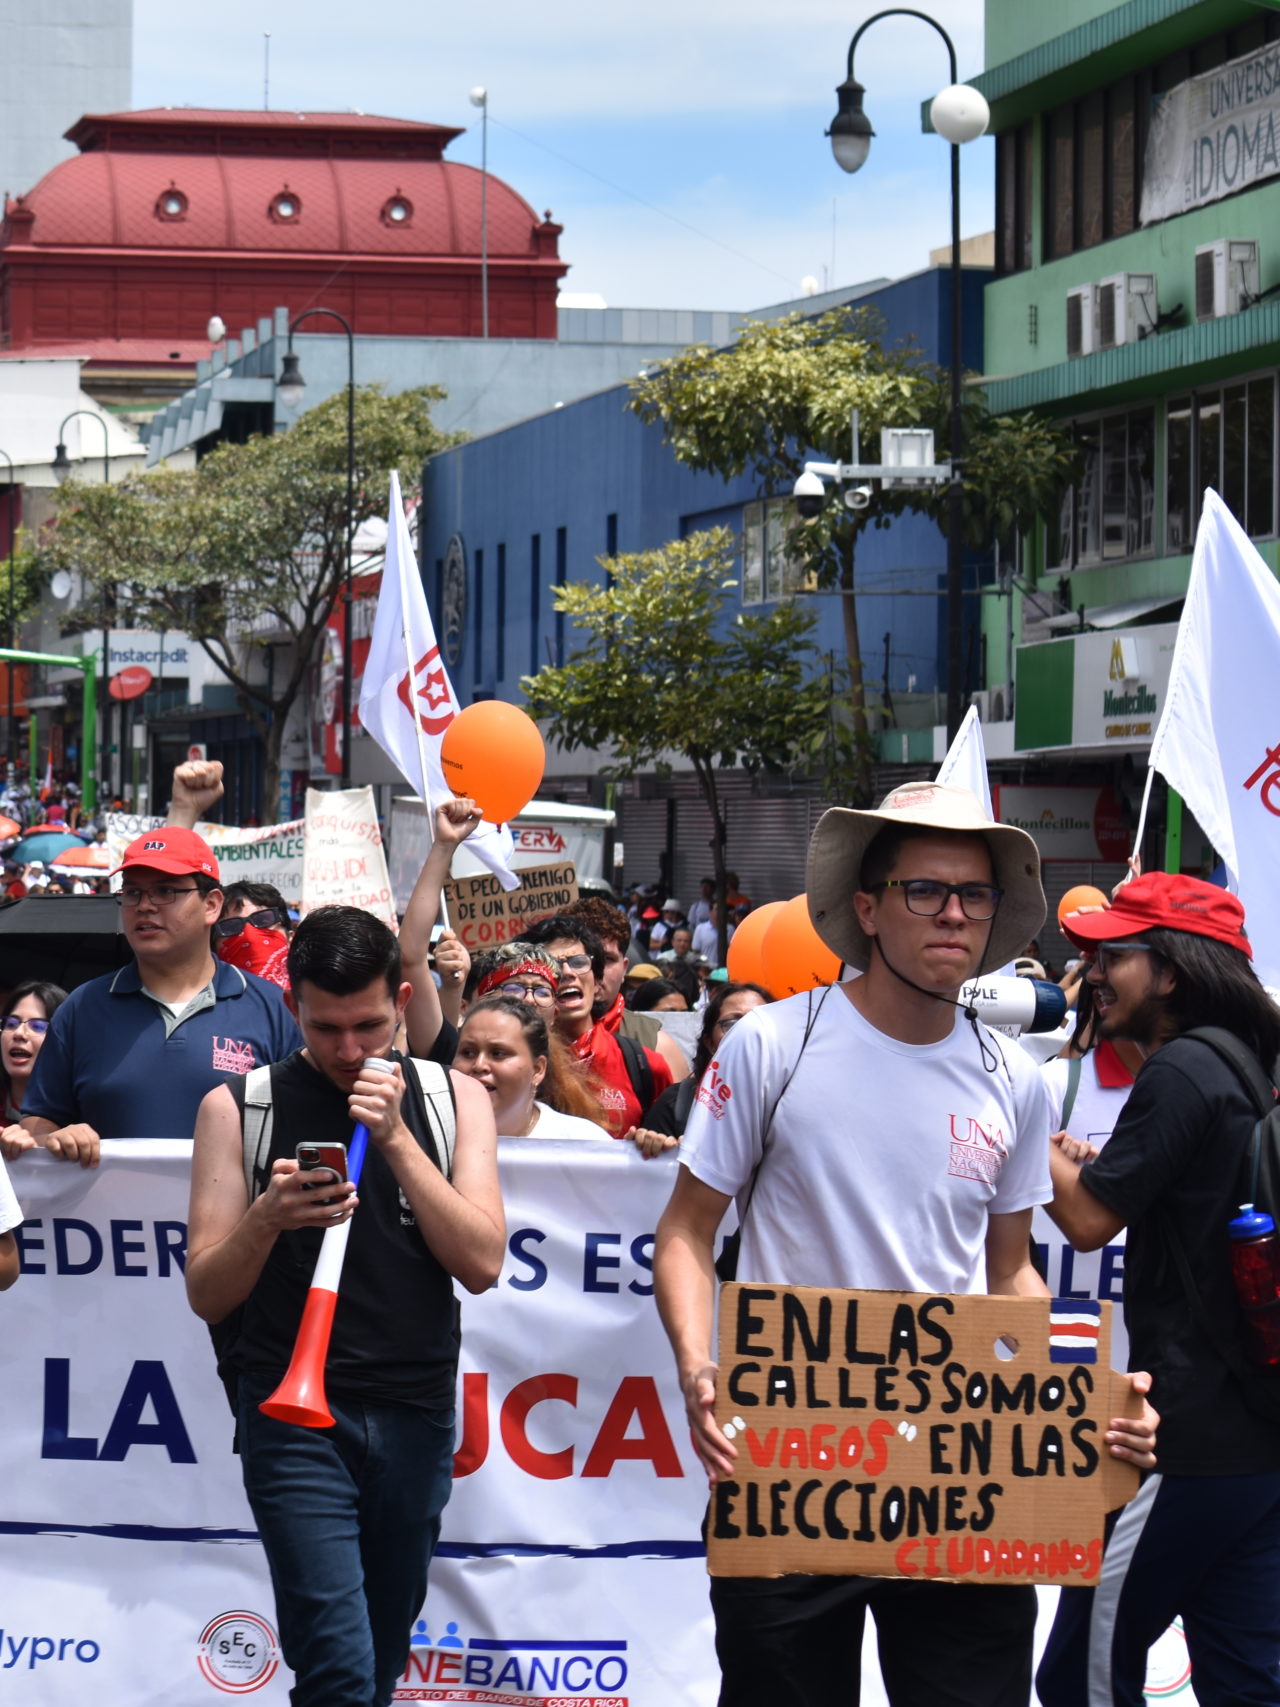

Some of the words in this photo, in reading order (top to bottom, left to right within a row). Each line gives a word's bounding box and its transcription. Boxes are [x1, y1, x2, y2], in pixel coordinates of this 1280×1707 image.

[109, 648, 189, 663] Instacredit
[1103, 684, 1157, 717] Montecillos
[1006, 817, 1091, 830] Montecillos
[144, 841, 166, 850] GAP
[213, 838, 304, 862] AMBIENTALES
[444, 884, 465, 902] EL
[471, 877, 505, 898] PEO
[458, 903, 477, 920] DE
[482, 901, 504, 916] UN
[509, 889, 571, 914] GOBIERNO
[963, 987, 998, 1000] PYLE
[212, 1035, 253, 1057] UNA
[947, 1113, 1005, 1150] UNA
[736, 1287, 832, 1363] EN
[844, 1297, 954, 1367] LAS
[728, 1362, 931, 1414] CALLES
[940, 1361, 1094, 1418] SOMOS
[41, 1357, 198, 1464] LA
[930, 1420, 992, 1476] EN
[1011, 1418, 1100, 1478] LAS
[713, 1478, 1004, 1543] ELECCIONES
[895, 1536, 1103, 1580] CIUDADANOS
[402, 1650, 628, 1692] NEBANCO
[445, 1690, 471, 1701] DEL
[475, 1693, 522, 1705] BANCO
[526, 1697, 545, 1707] DE
